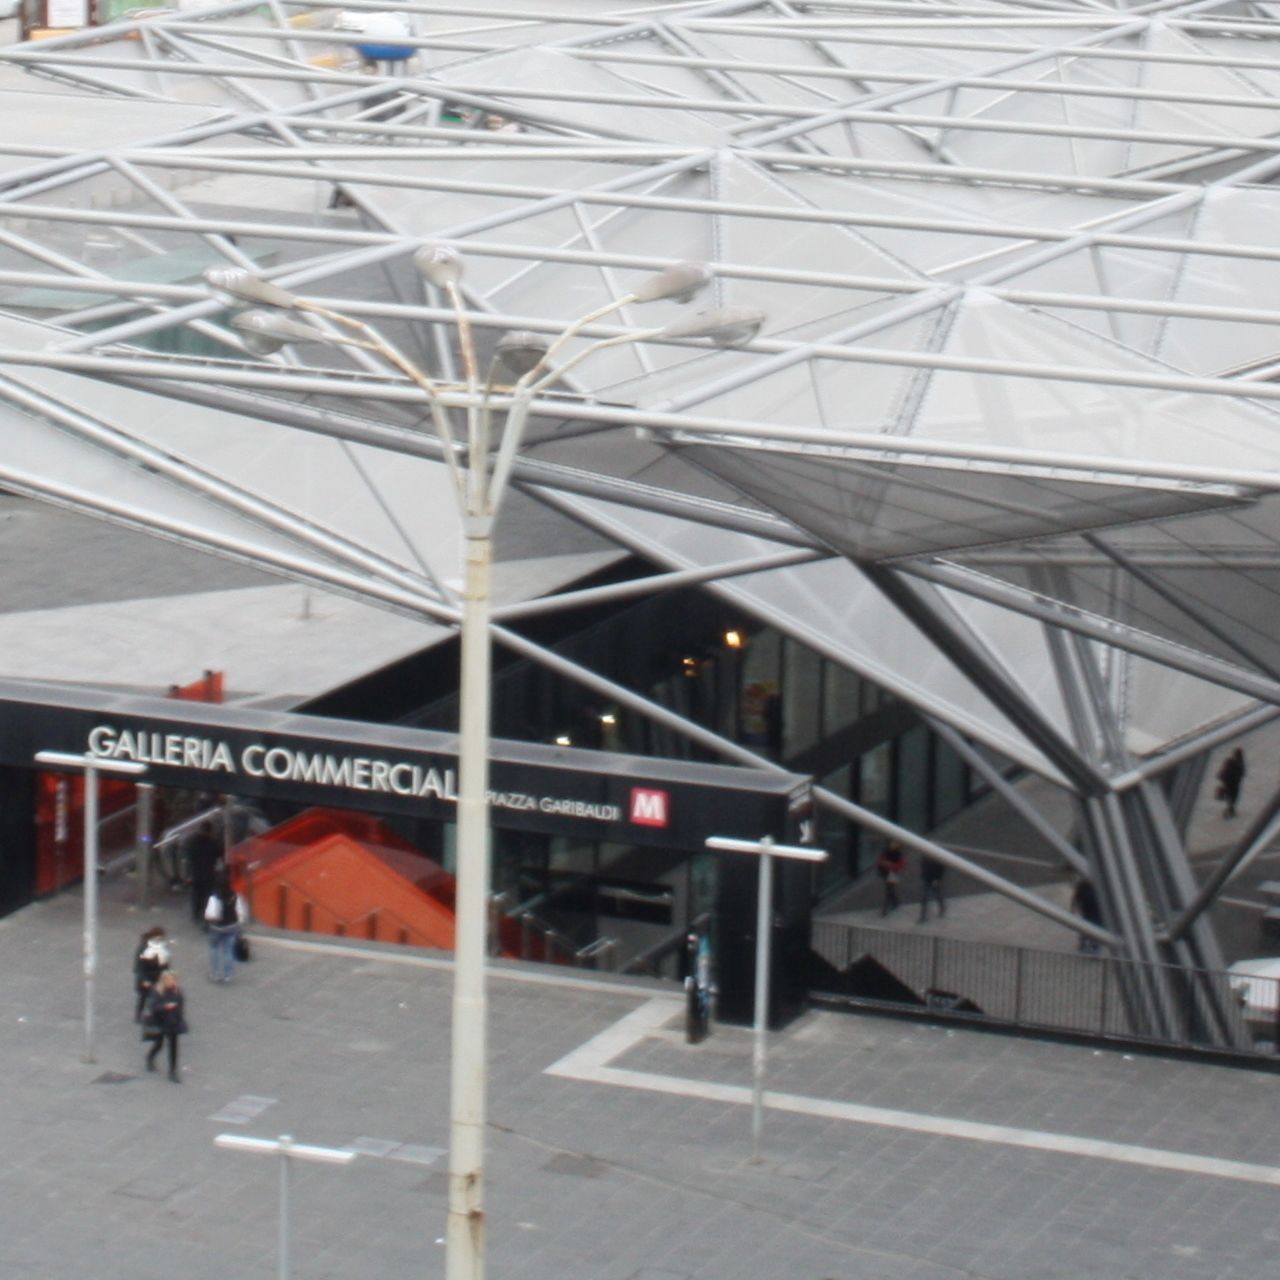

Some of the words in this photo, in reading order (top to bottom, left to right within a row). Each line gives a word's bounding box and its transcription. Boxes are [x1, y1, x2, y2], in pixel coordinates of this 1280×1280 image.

[88, 726, 236, 774] GALLERIA
[241, 745, 460, 803] COMMERCIAL
[485, 790, 536, 810] PIAZZA
[539, 797, 622, 821] GARIBALDI
